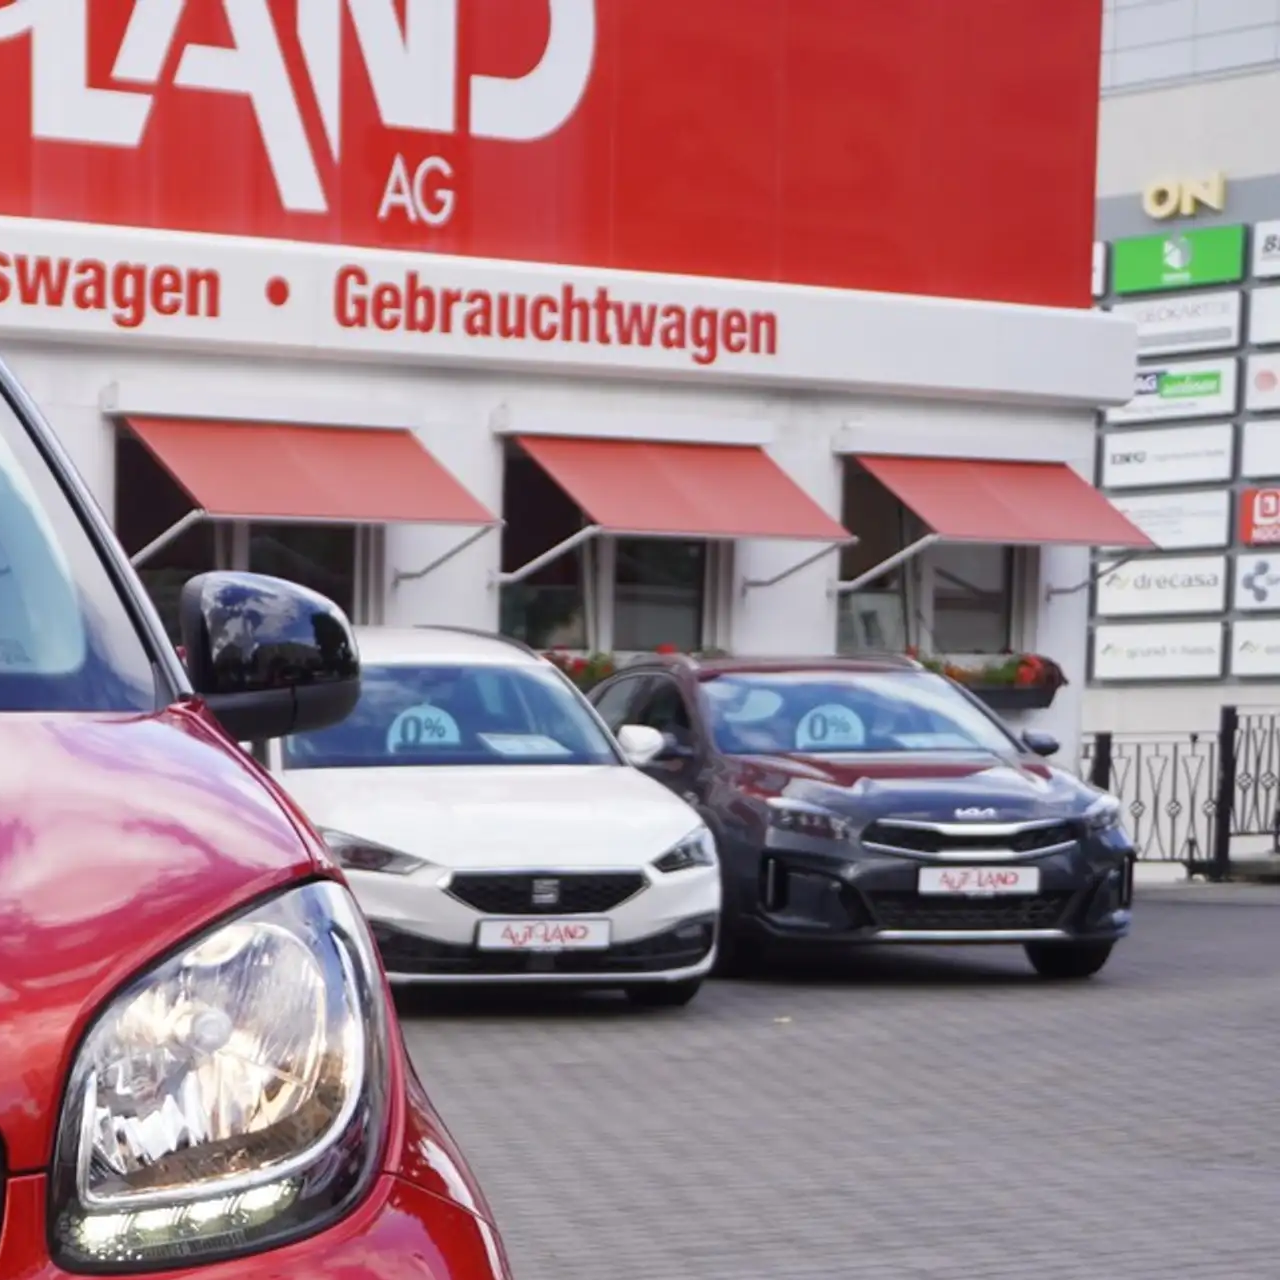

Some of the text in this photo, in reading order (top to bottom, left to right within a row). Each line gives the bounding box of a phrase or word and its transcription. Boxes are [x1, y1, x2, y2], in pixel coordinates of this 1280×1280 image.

[377, 154, 455, 225] AG
[333, 264, 778, 366] Gebrauchtwagen
[1132, 572, 1219, 590] drecasa
